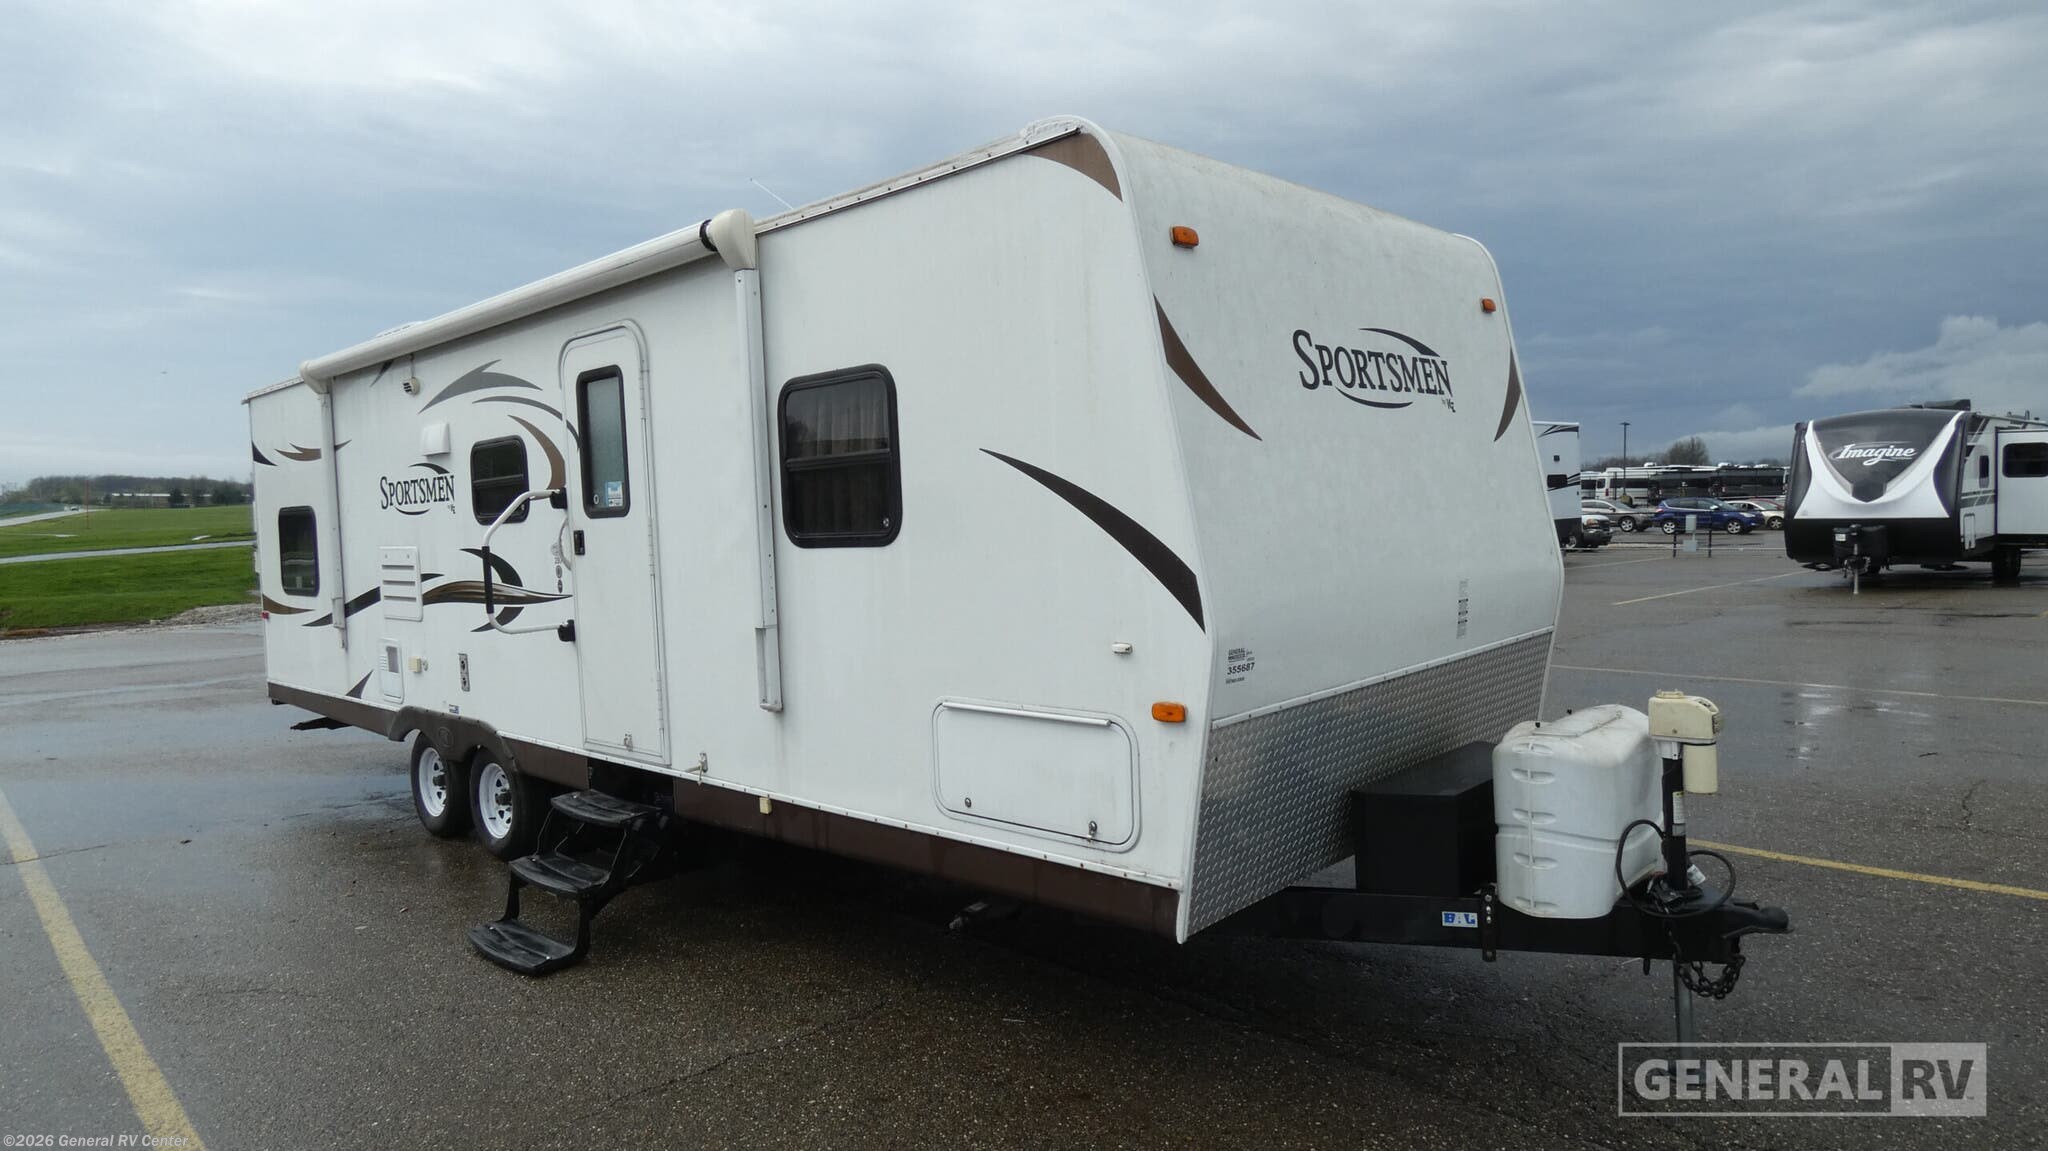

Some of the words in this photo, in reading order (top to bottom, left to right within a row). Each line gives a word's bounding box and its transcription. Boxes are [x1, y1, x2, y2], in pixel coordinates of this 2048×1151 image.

[1292, 329, 1453, 397] SPORTSMEN
[1836, 443, 1918, 466] Imagine
[379, 475, 455, 510] SPORTSMEN
[1226, 661, 1256, 675] 355687
